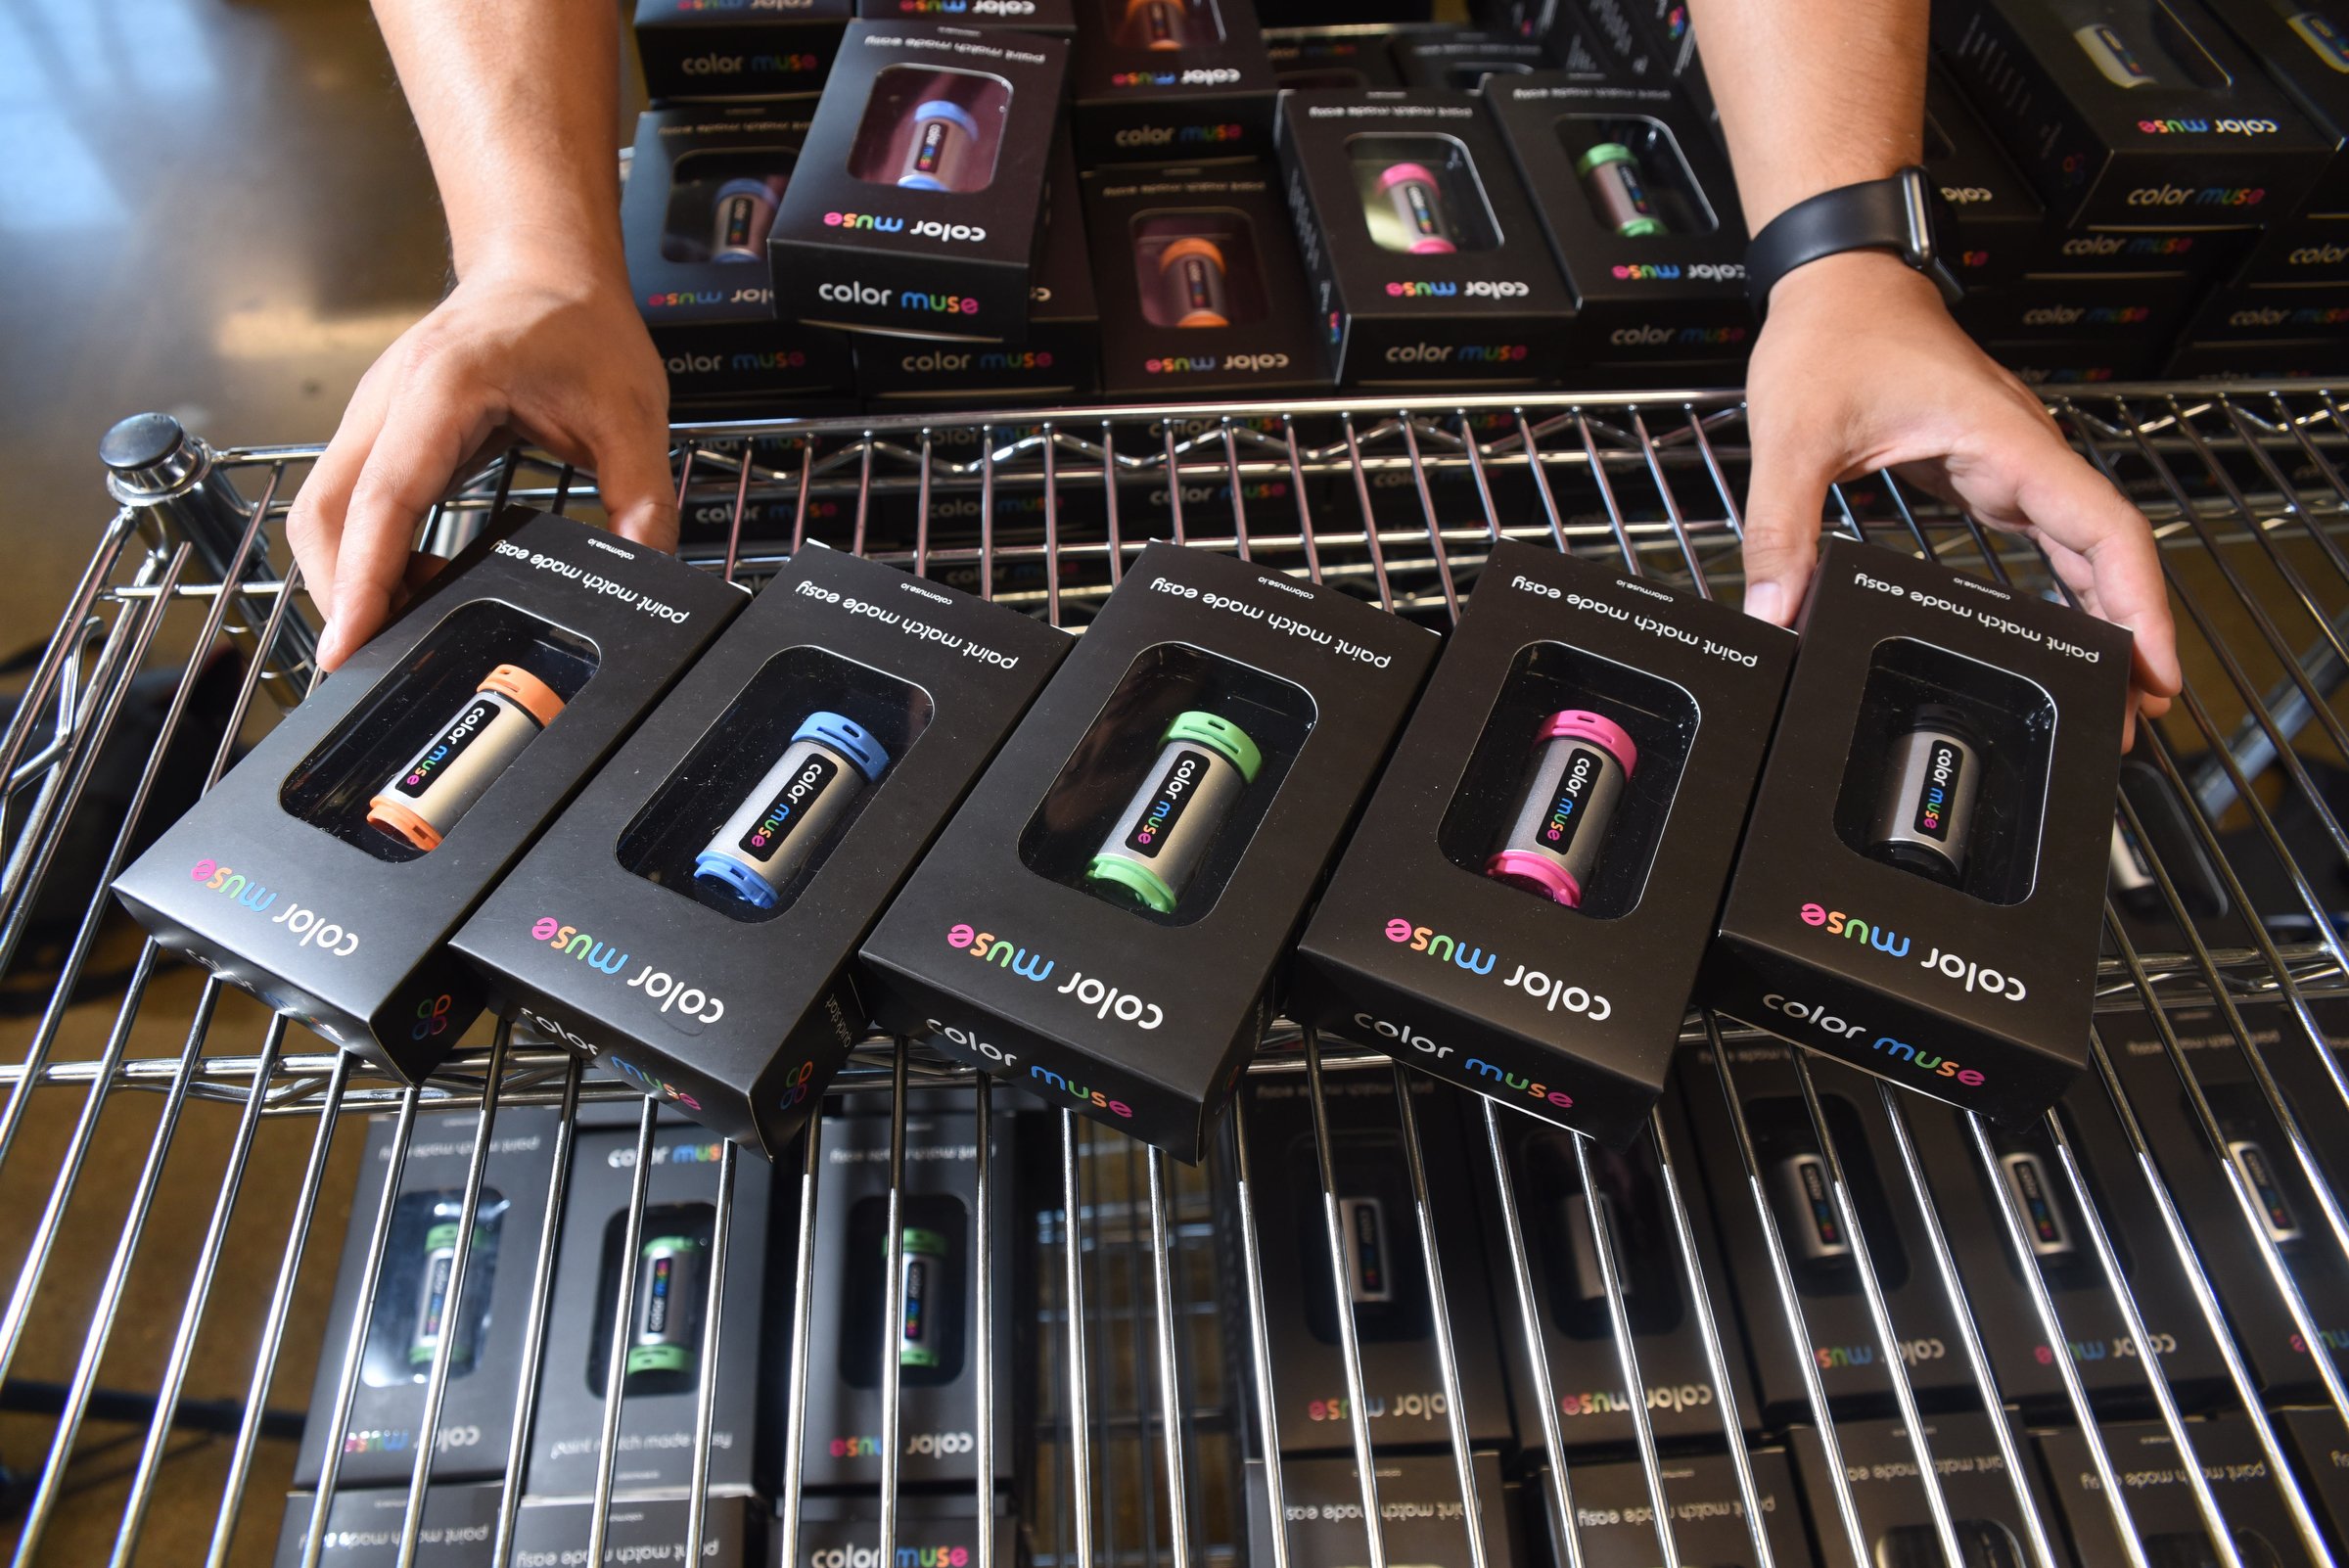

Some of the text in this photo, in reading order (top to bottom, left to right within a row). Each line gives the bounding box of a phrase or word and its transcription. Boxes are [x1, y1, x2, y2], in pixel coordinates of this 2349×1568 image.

[681, 52, 818, 76] color muse
[1179, 69, 1241, 86] color
[1115, 123, 1243, 147] color muse
[2137, 118, 2281, 137] color muse
[1940, 187, 1993, 205] colo
[2126, 182, 2267, 207] color muse
[823, 211, 987, 243] color muse
[2061, 234, 2193, 256] color muse
[1611, 263, 1681, 280] muse
[648, 291, 723, 307] muse
[818, 281, 980, 315] color muse
[1385, 280, 1530, 300] color muse
[2022, 303, 2086, 326] color
[2229, 306, 2291, 327] color
[1610, 324, 1746, 346] color muse
[663, 350, 806, 374] olor muse
[901, 350, 1053, 372] color muse
[1144, 353, 1290, 374] color muse
[1385, 342, 1529, 363] color muse
[587, 537, 635, 560] colormuse.io
[489, 538, 690, 623] paint match made easy
[795, 579, 840, 603] easy
[900, 582, 953, 605] colormuse.io
[1258, 576, 1314, 599] colormuse.io
[1616, 578, 1674, 602] colormuse.io
[1953, 576, 2011, 600] colormuse.io
[842, 597, 900, 624] made
[1149, 576, 1392, 669] paint match made easy
[1511, 576, 1758, 668] paint match made easy
[1854, 573, 2099, 663] paint match made easy
[901, 618, 963, 648] match
[962, 641, 1019, 669] paint
[406, 707, 484, 785] color muse
[1546, 758, 1590, 841] color muse
[1923, 748, 1953, 829] color muse
[752, 763, 822, 848] color muse
[1137, 760, 1195, 845] color muse
[191, 858, 359, 956] color muse
[1800, 902, 2026, 1001] color muse
[531, 917, 724, 1024] color muse
[947, 924, 1163, 1030] color muse
[1385, 918, 1611, 1021] color muse
[825, 993, 852, 1048] quick start
[1763, 993, 1985, 1085] color muse
[926, 1018, 1132, 1118] color muse
[1354, 1012, 1454, 1058] color
[1464, 1058, 1574, 1108] muse
[611, 1056, 702, 1111] muse
[1393, 1392, 1448, 1420] olor
[905, 1431, 974, 1459] color
[896, 1545, 968, 1568] muse
